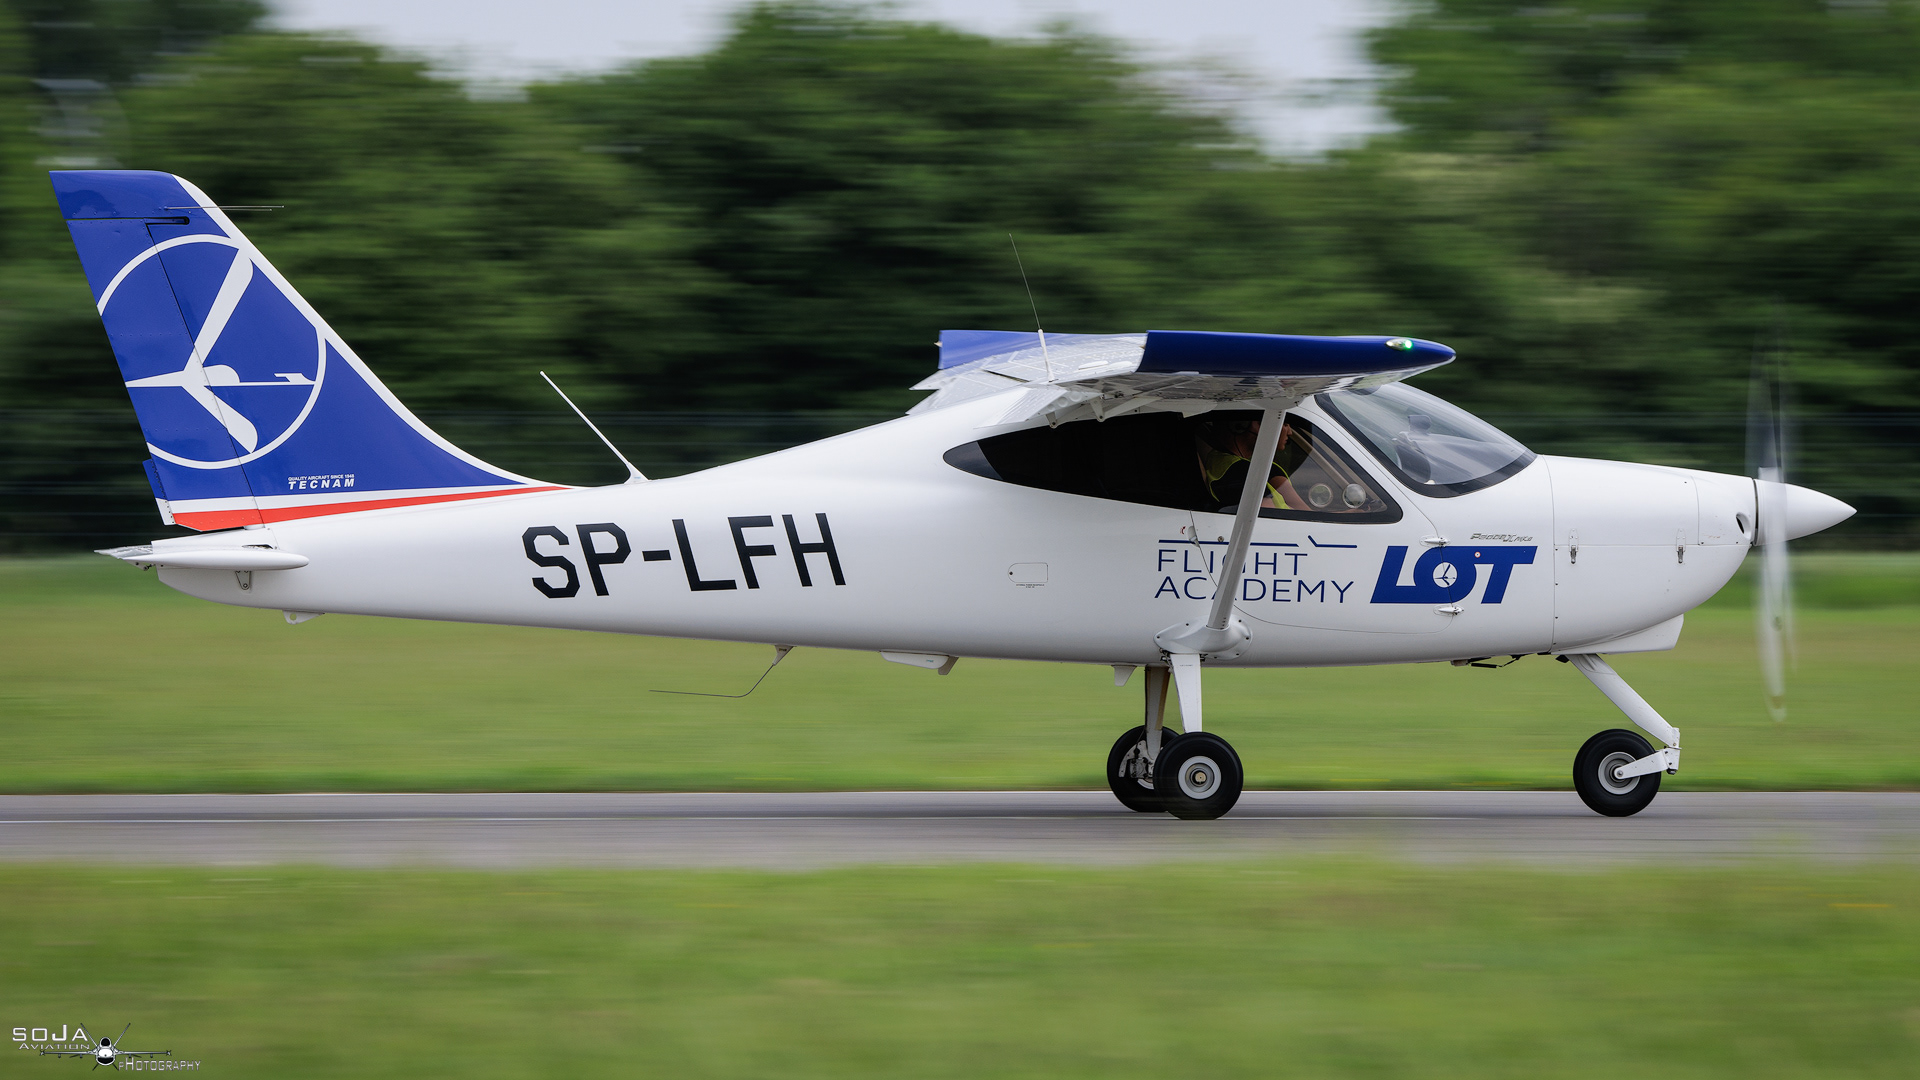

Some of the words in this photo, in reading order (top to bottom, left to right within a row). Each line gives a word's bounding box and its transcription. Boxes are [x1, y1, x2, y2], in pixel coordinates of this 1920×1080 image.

[288, 478, 355, 490] TECNAM
[522, 513, 846, 599] SP-LFH
[1370, 546, 1538, 604] LOT
[1154, 576, 1354, 603] ACDEMY
